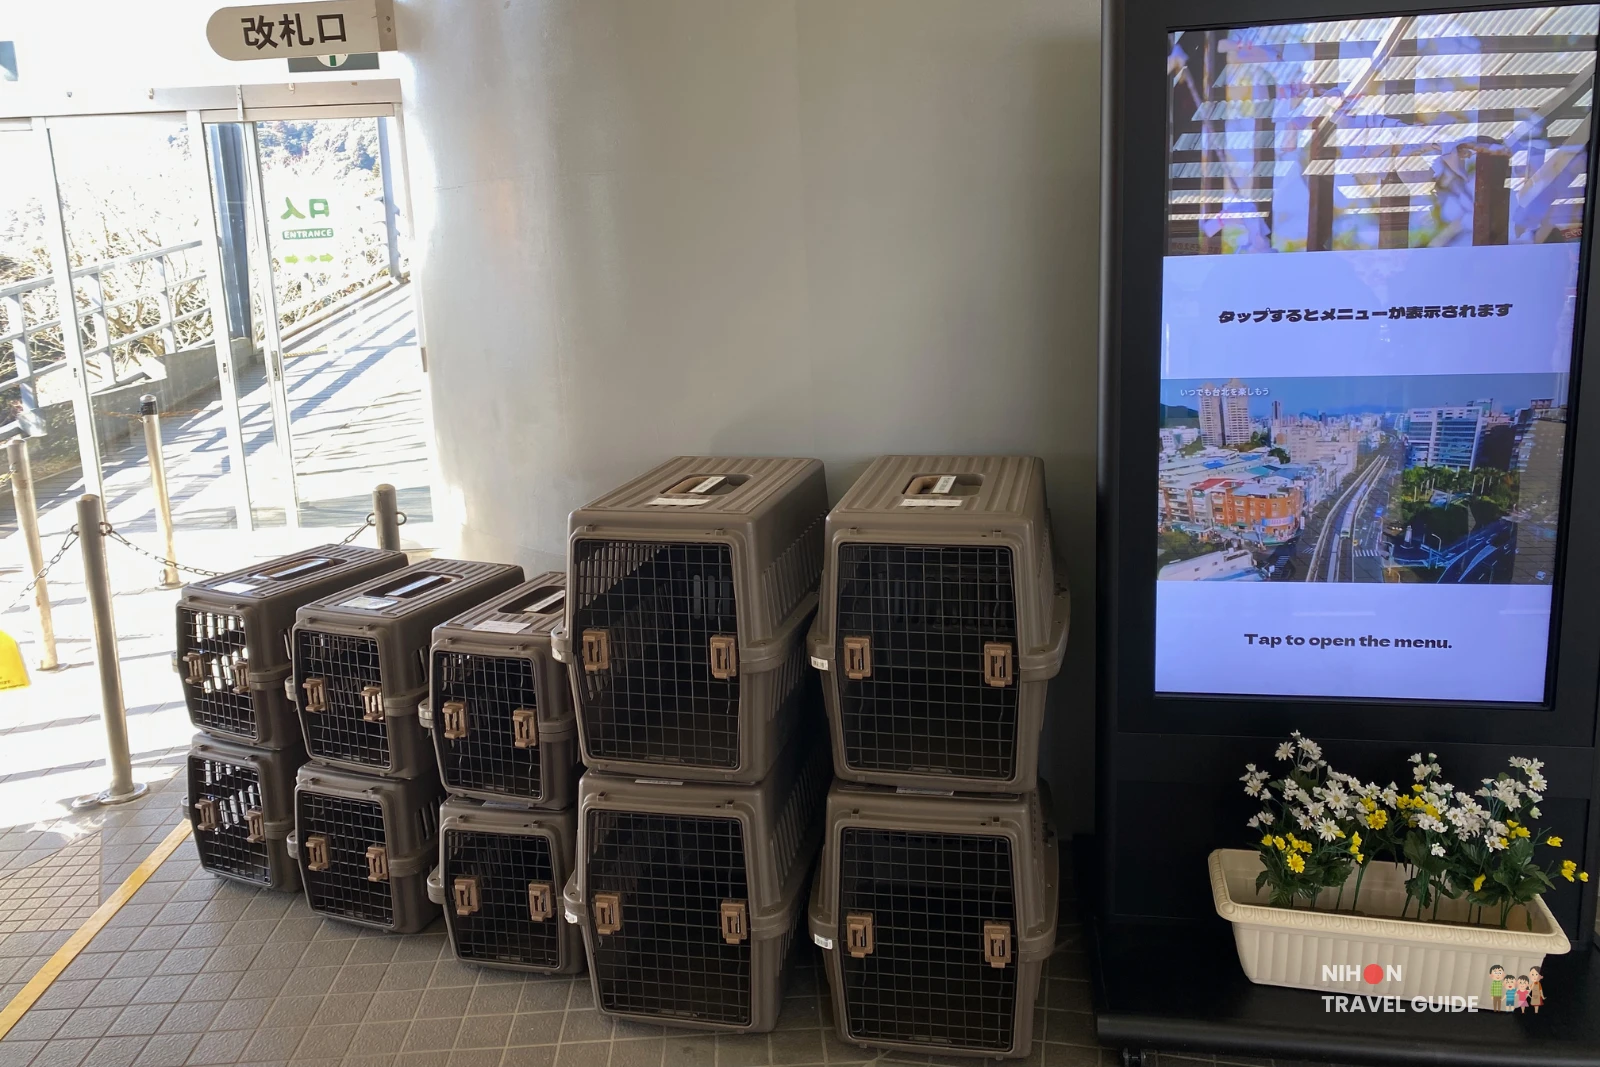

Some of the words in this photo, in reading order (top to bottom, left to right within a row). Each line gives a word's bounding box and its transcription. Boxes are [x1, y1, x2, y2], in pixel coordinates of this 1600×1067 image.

[241, 13, 347, 50] 改札口
[280, 196, 330, 220] 入口
[283, 229, 333, 239] ENTRANCE
[1218, 303, 1514, 324] タップするとメニューが表示されます
[1180, 387, 1270, 397] いつでも台北を楽しもう
[1244, 633, 1282, 648] Tap
[1285, 634, 1305, 646] to
[1309, 637, 1355, 649] open
[1359, 635, 1391, 647] the
[1394, 638, 1453, 649] menu.
